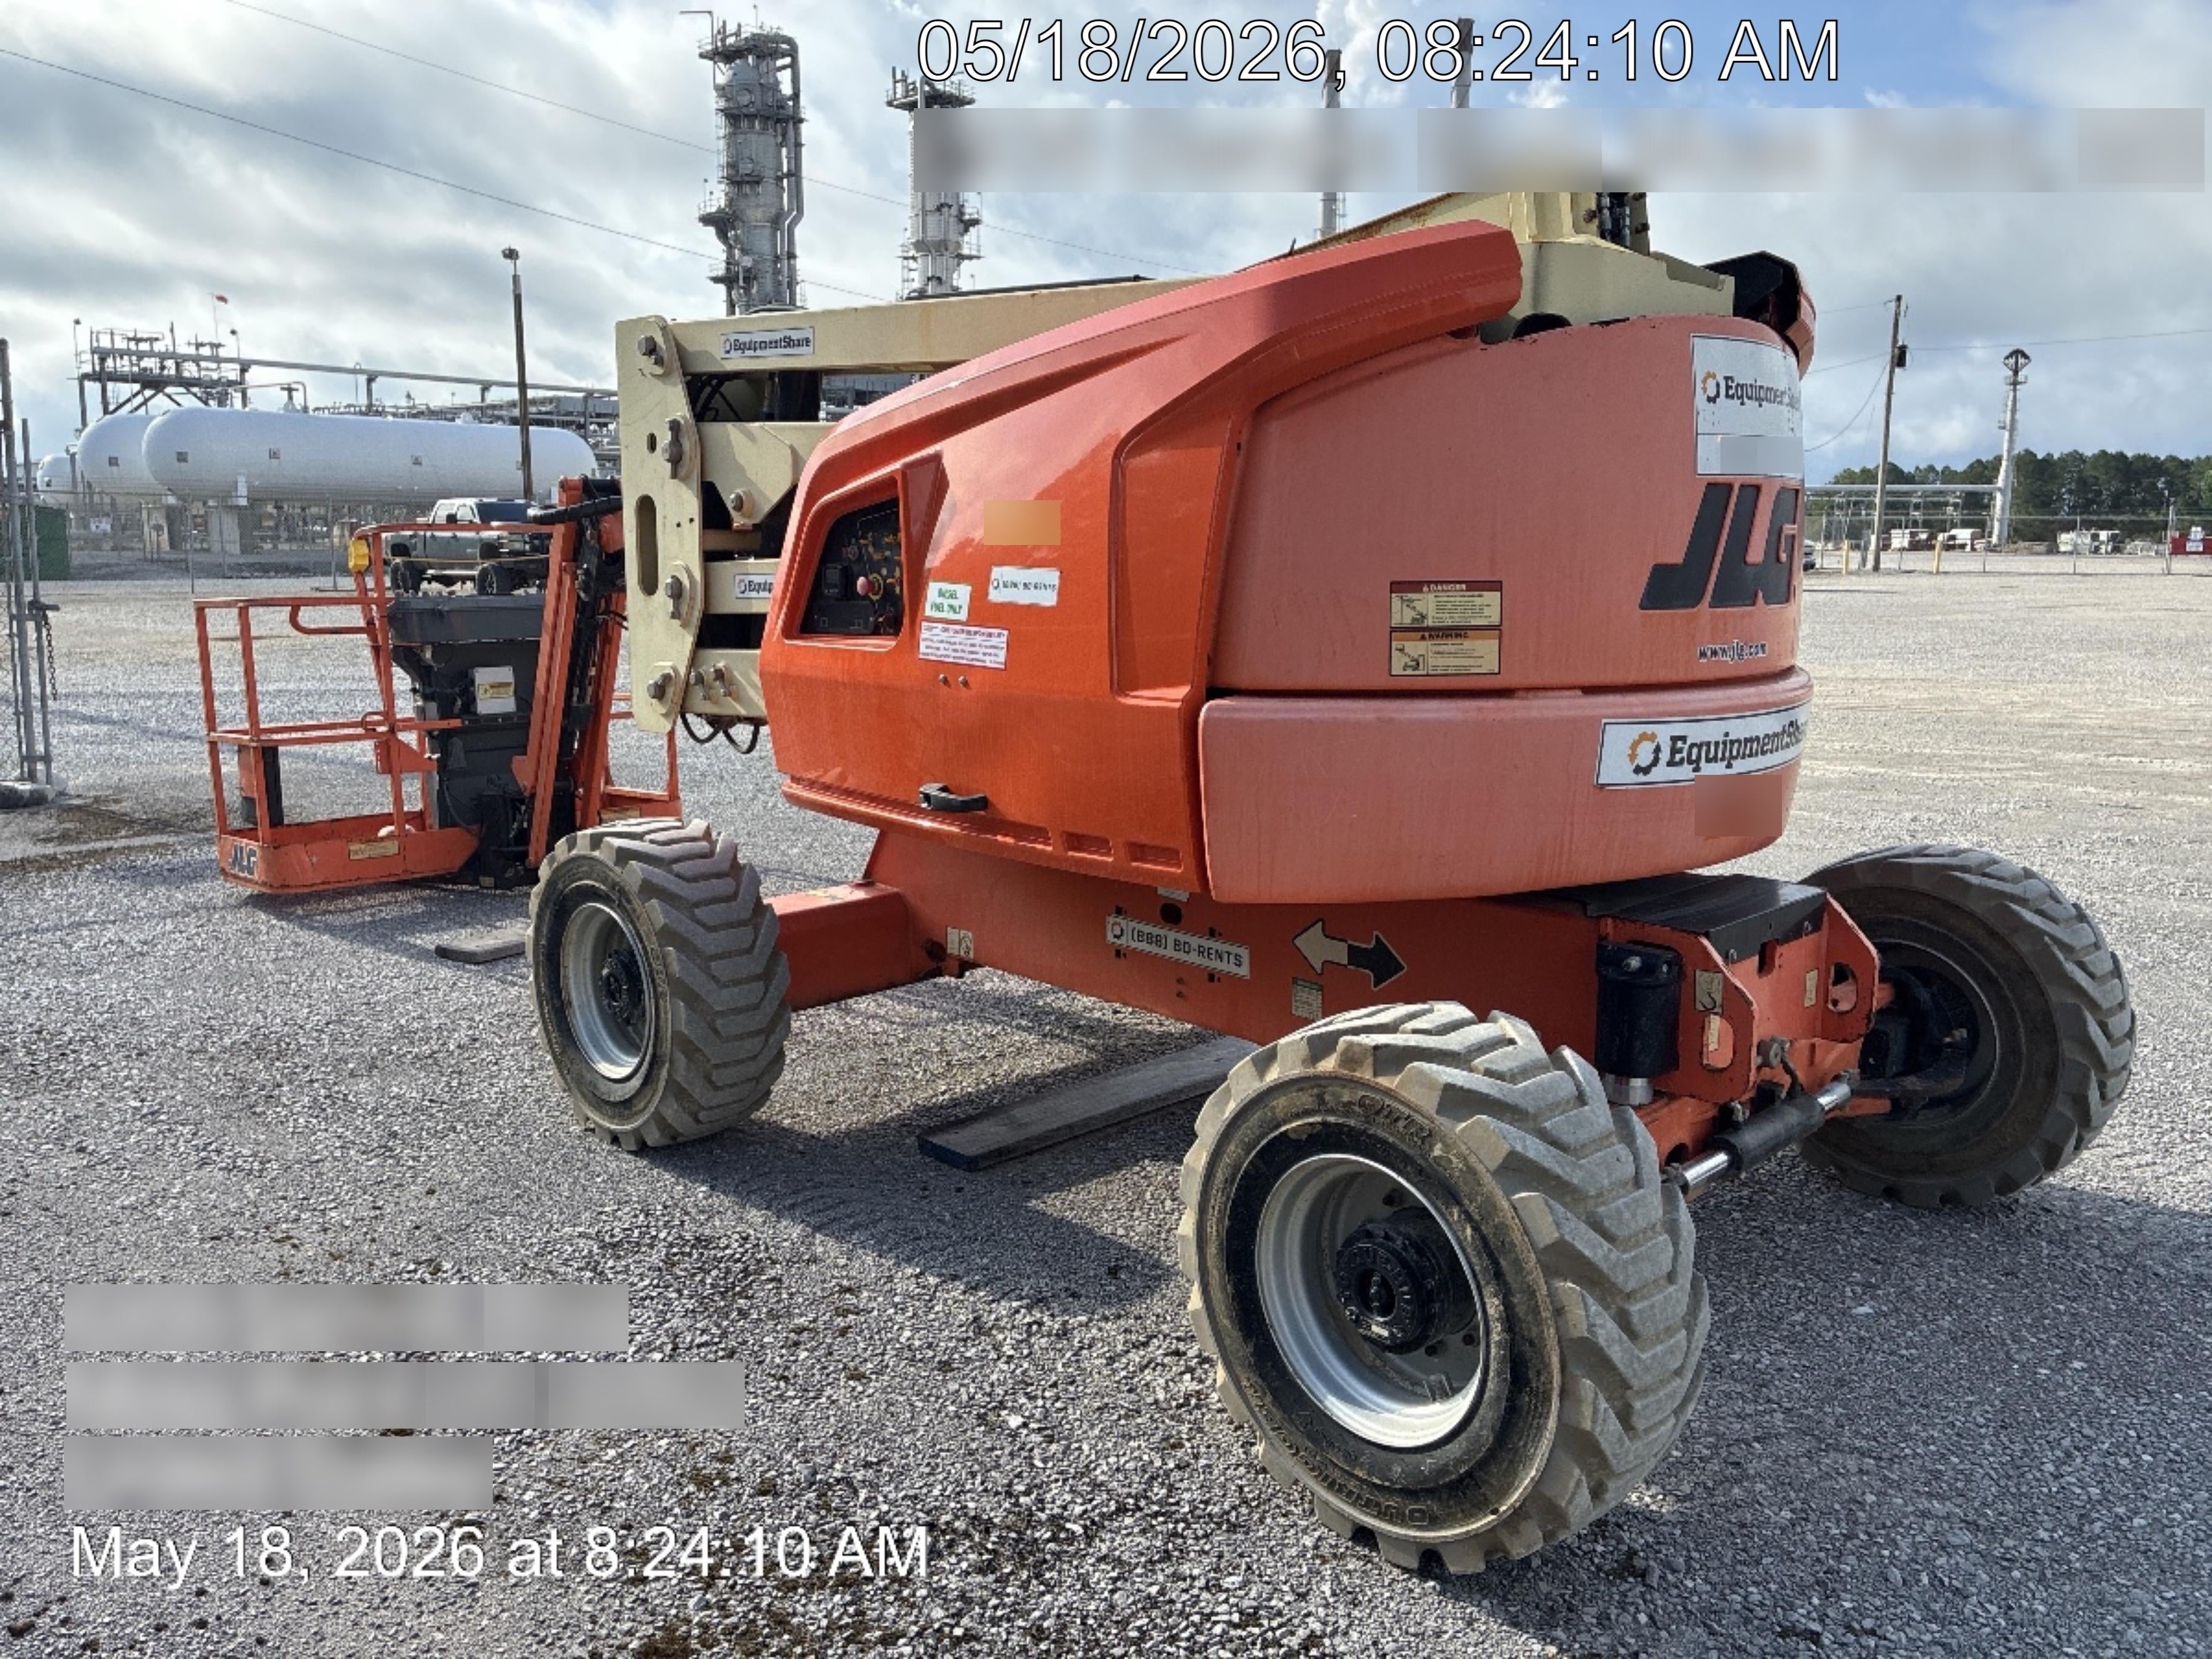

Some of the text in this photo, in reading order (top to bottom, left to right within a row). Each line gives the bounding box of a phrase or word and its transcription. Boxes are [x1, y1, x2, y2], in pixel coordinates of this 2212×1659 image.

[1639, 482, 1798, 610] JLG
[1698, 640, 1767, 663] www.jlg.com
[229, 843, 257, 877] JLG
